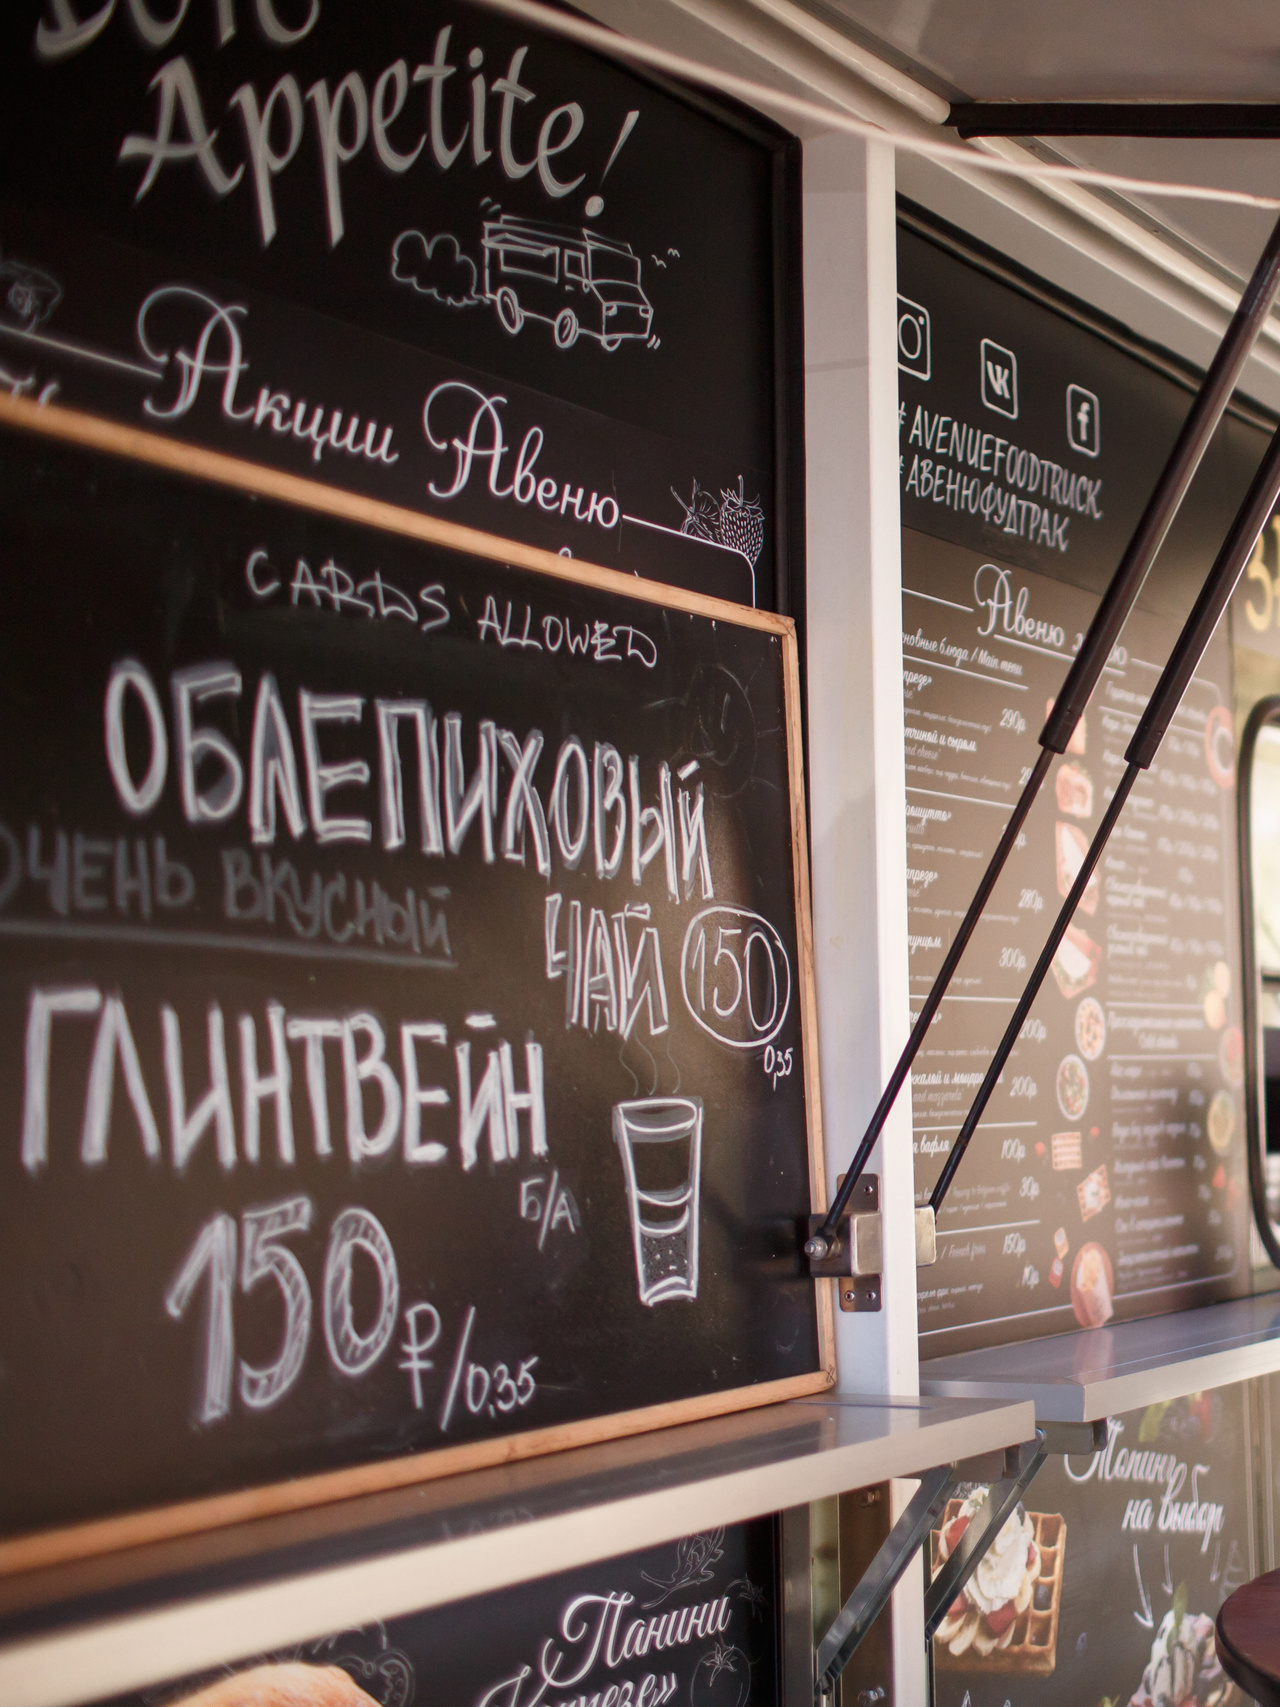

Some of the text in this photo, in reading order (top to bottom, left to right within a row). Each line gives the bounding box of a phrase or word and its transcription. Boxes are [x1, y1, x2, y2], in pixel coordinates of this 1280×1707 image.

[119, 25, 640, 249] Appetite!
[138, 286, 620, 528] Акции Авеню
[246, 551, 658, 669] CARDS ALLOWED
[973, 563, 1064, 647] Авеню
[104, 657, 713, 904] ОБЛЕПИХОВЫЙ
[221, 846, 453, 956] ВКУСНЫЙ
[545, 892, 669, 1038] ЧАЙ
[692, 925, 778, 1032] 150
[20, 984, 548, 1173] ГЛИНТВЕЙН
[763, 1044, 794, 1092] 0,35
[518, 1168, 576, 1251] Б/А
[1121, 1461, 1225, 1553] на выбор
[541, 1591, 734, 1689] Панини
